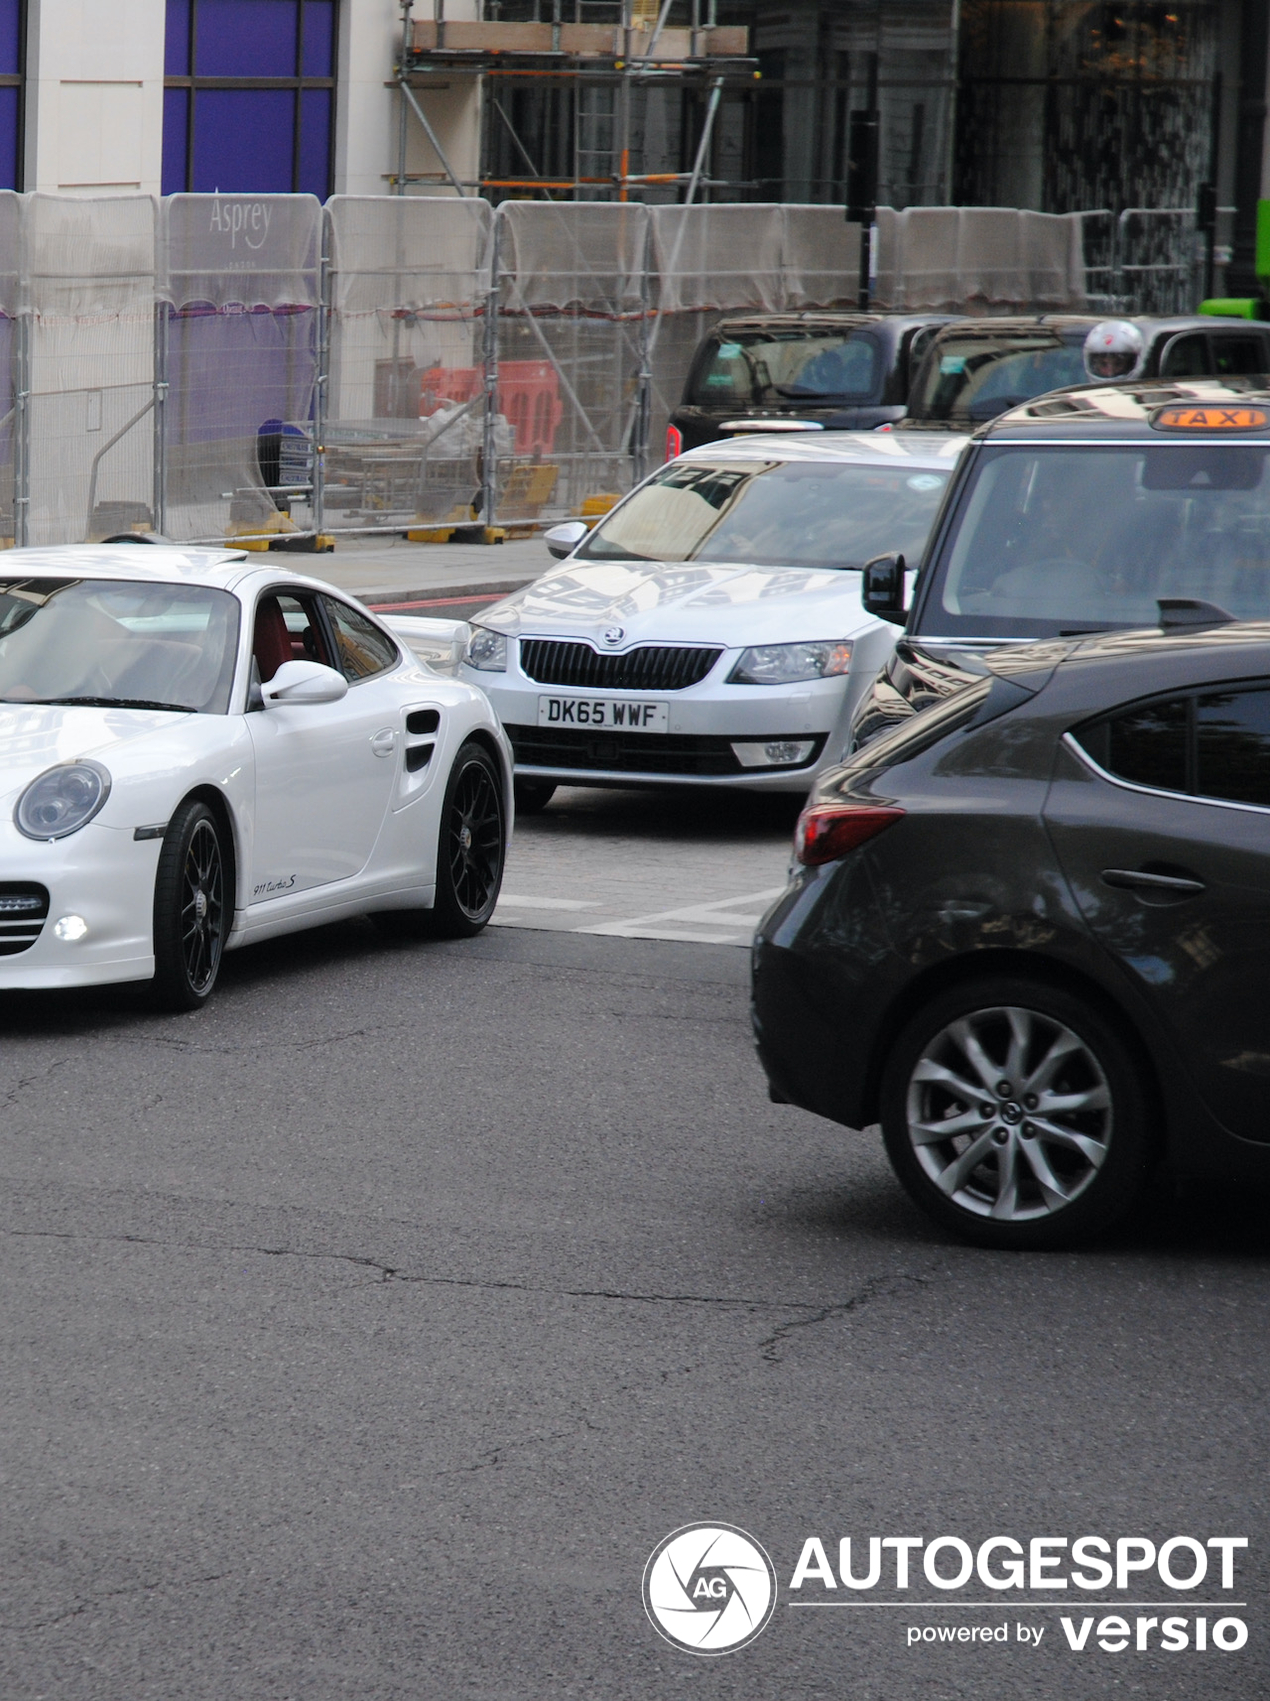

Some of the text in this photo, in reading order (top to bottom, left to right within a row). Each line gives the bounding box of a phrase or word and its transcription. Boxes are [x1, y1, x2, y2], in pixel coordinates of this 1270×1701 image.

[210, 186, 274, 249] Asprey
[1171, 411, 1256, 425] TAXI
[548, 700, 657, 727] DK65 WWF
